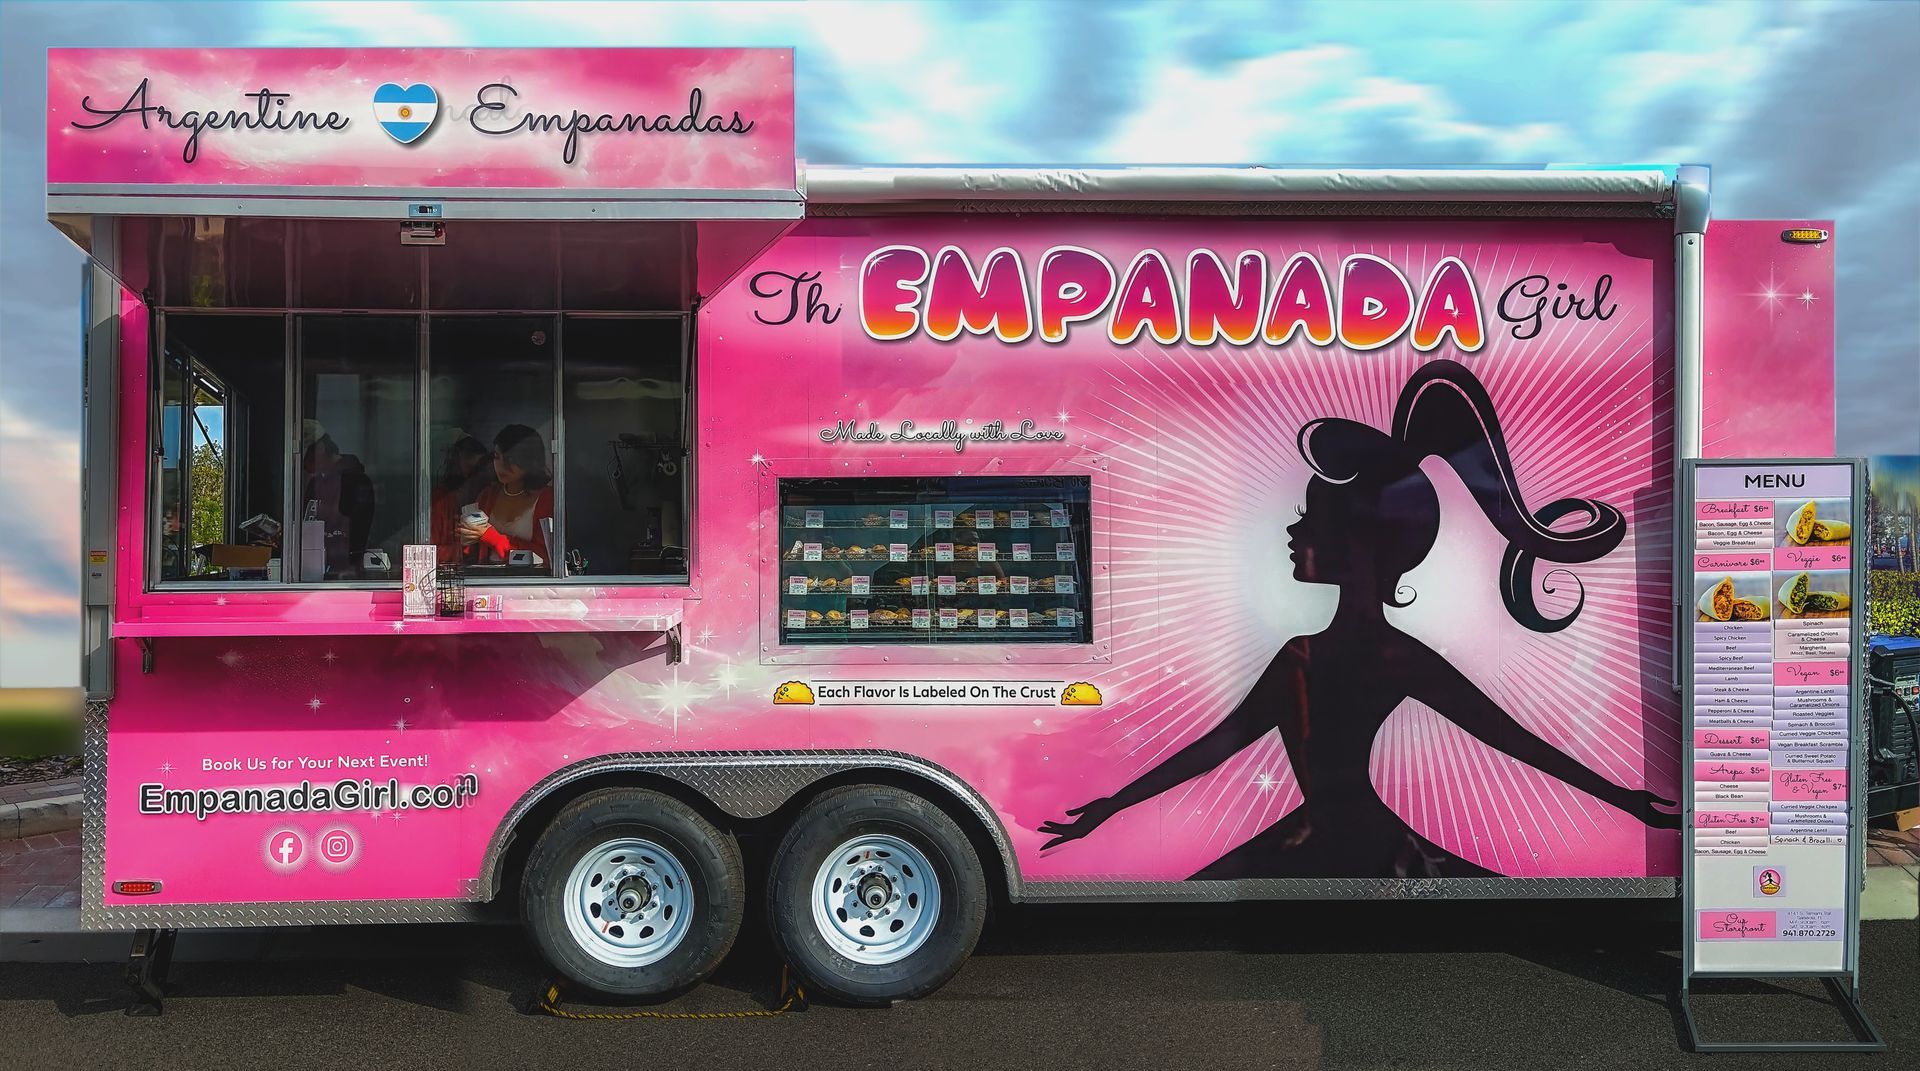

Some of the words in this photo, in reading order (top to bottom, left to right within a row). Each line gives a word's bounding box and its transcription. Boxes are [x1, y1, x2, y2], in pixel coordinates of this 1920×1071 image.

[72, 77, 350, 164] Argentine
[470, 84, 754, 164] Empanadas
[858, 244, 1485, 352] EMPANADA
[1496, 274, 1618, 341] Girl
[819, 419, 885, 442] Made
[890, 419, 966, 452] Locally
[968, 419, 1008, 441] with
[1009, 419, 1064, 441] Love
[1744, 474, 1805, 488] MENU
[1701, 503, 1750, 518] Breakfast
[1698, 557, 1748, 568] Carnivore
[1787, 551, 1820, 568] Veggie
[1787, 665, 1820, 682] Vegan
[818, 685, 851, 698] Each
[855, 685, 896, 698] Flavor
[900, 685, 908, 698] Is
[913, 685, 966, 698] Labeled
[970, 686, 988, 698] On
[992, 685, 1017, 698] The
[1021, 686, 1056, 698] Crust
[1704, 732, 1744, 744] Dessert
[202, 758, 242, 771] Book
[247, 757, 267, 770] Us
[271, 756, 294, 770] for
[298, 756, 333, 770] Your
[337, 756, 375, 768] Next
[380, 754, 428, 768] Event!
[1709, 764, 1745, 780] Arepa
[1780, 772, 1808, 786] Gluten
[1809, 772, 1832, 783] Free
[1801, 782, 1828, 799] Vegan
[1699, 813, 1725, 828] Gluten
[1725, 814, 1747, 823] Free
[1726, 913, 1748, 924] Our
[1713, 920, 1766, 938] Storefront
